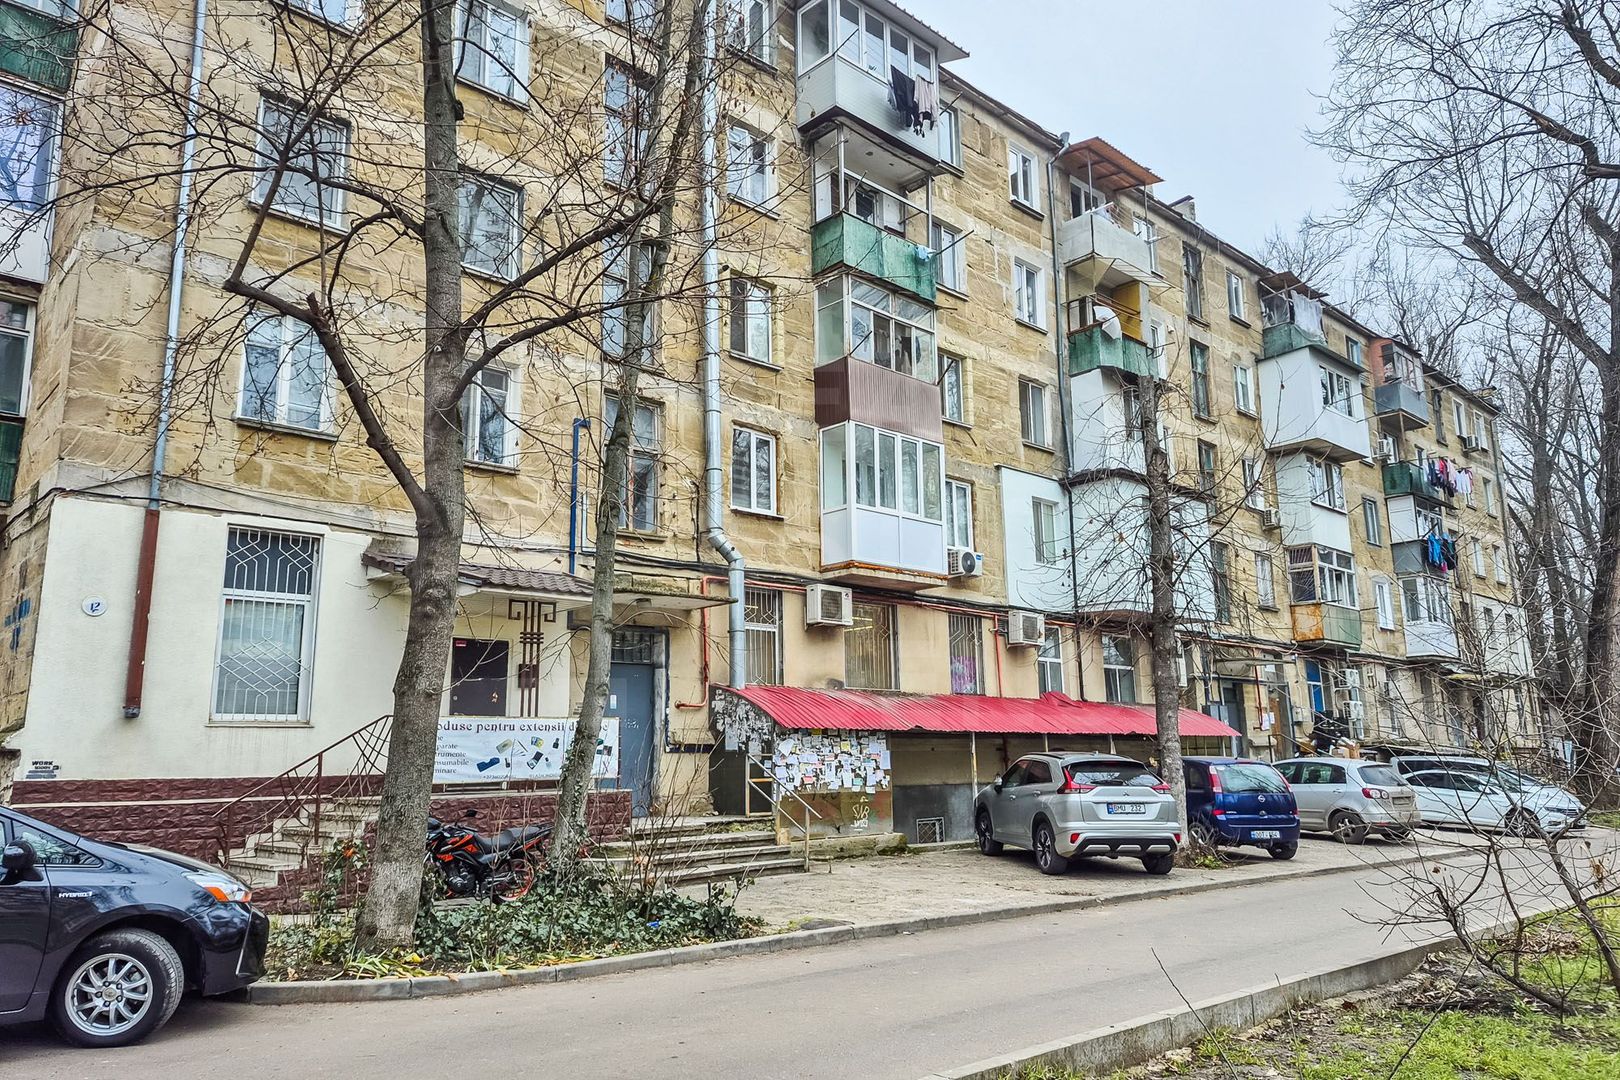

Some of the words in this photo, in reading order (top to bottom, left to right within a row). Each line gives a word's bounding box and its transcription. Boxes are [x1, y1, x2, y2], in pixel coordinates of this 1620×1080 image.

[90, 601, 101, 613] 12
[437, 720, 472, 731] oduse
[476, 722, 515, 733] pentru
[519, 722, 565, 732] extensii
[437, 743, 458, 751] parate
[1130, 804, 1142, 812] 232
